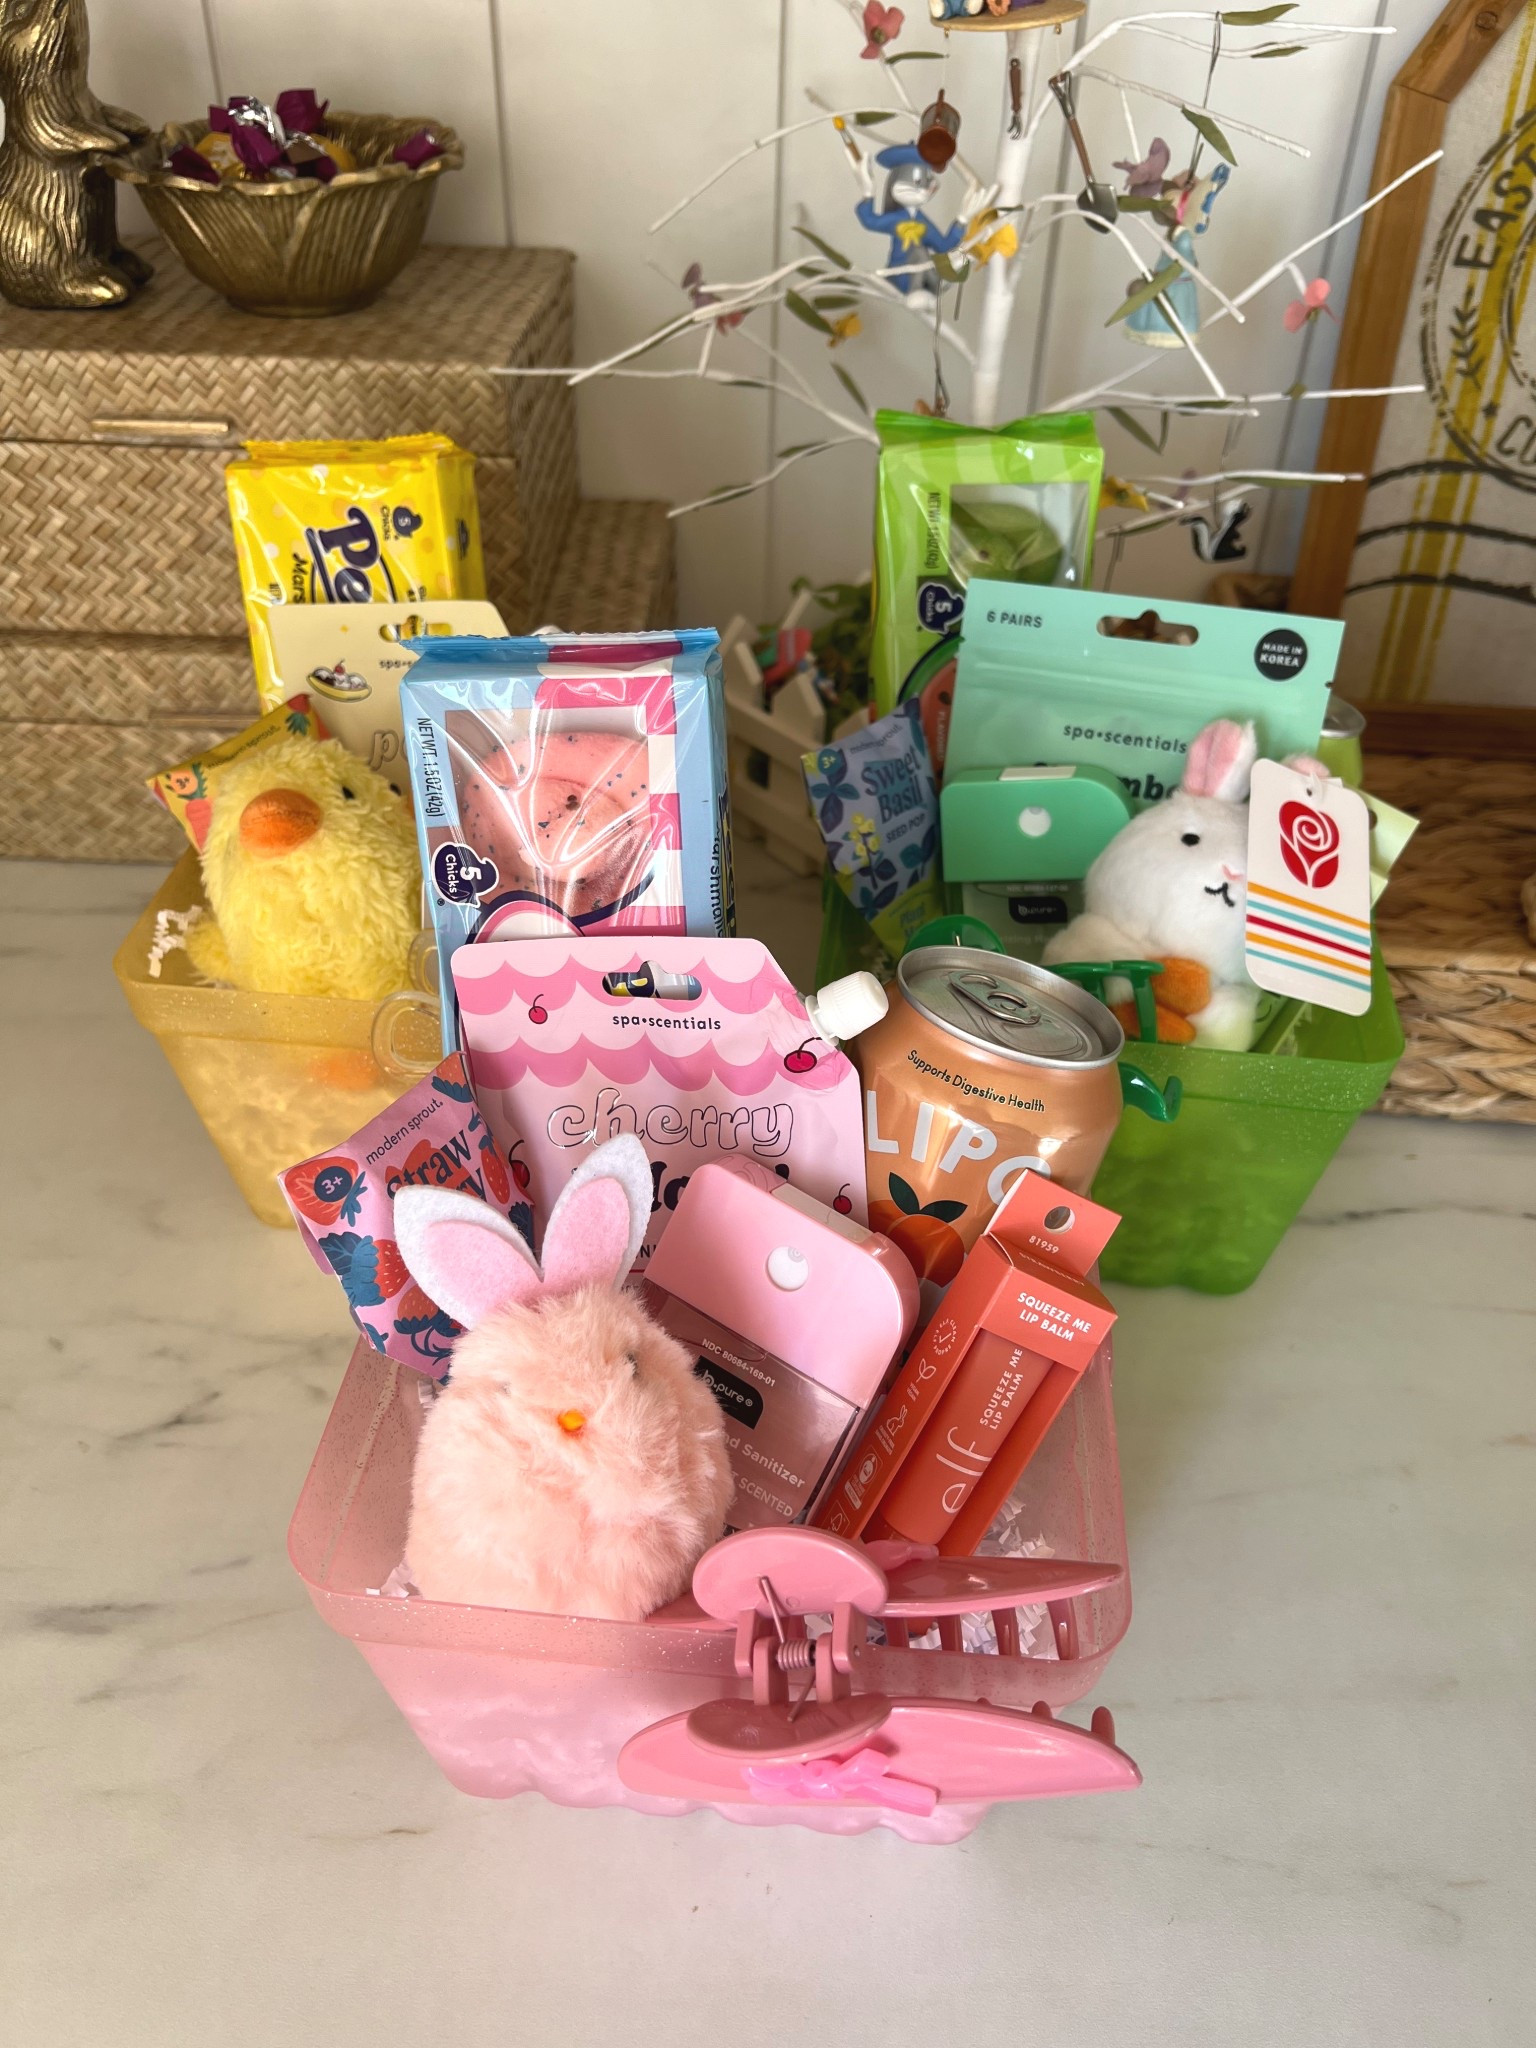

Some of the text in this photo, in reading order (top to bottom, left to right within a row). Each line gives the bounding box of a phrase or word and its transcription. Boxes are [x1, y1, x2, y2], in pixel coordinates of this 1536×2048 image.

[935, 601, 952, 613] 5
[987, 611, 1043, 628] 6 PAIRS
[1259, 654, 1300, 668] KOREA
[1262, 643, 1303, 655] MADE IN
[860, 745, 921, 797] Sweet
[877, 782, 926, 824] Basil
[885, 822, 909, 844] SEED
[445, 853, 458, 894] Chicks
[460, 866, 482, 883] 5
[907, 1049, 1046, 1113] Supports Digestive Health
[547, 1087, 795, 1158] cherry
[365, 1125, 409, 1165] modern
[321, 1174, 344, 1195] 3+
[1028, 1235, 1060, 1255] 81959
[1017, 1292, 1092, 1335] SQUEEZE ME
[1019, 1309, 1075, 1342] LIP BALM
[701, 1338, 777, 1388] NDC 80684-169-01
[979, 1347, 1023, 1426] SQUEEZE ME
[988, 1373, 1024, 1430] LIP BALM
[741, 1444, 806, 1489] Sanitizer
[738, 1478, 794, 1518] SCENTED
